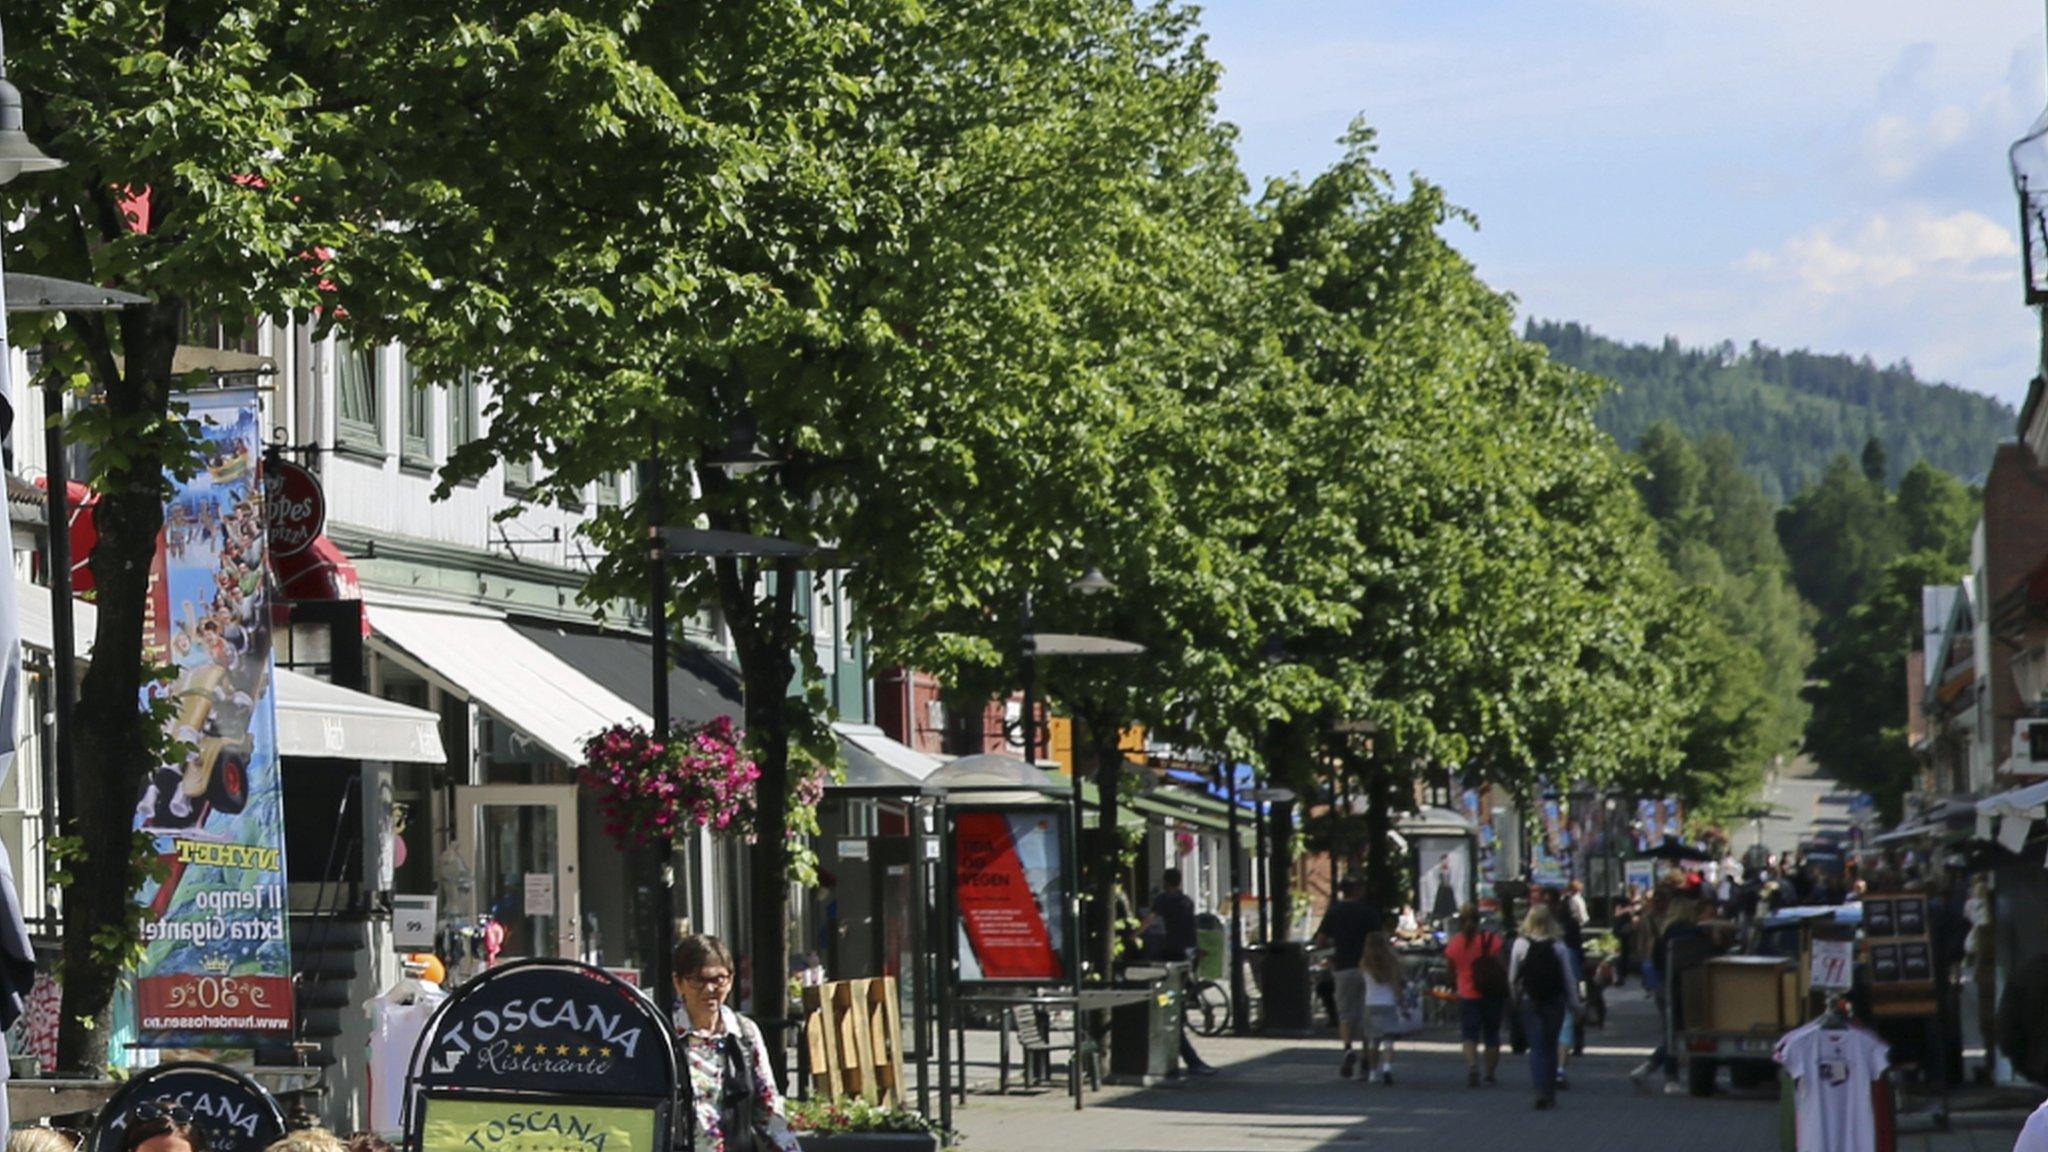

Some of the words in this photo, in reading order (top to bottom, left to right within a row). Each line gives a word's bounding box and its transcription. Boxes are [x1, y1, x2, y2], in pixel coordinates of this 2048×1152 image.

[441, 996, 642, 1059] TOSCANA
[476, 1038, 615, 1075] Ristorante
[464, 1110, 609, 1151] TOSCANA
